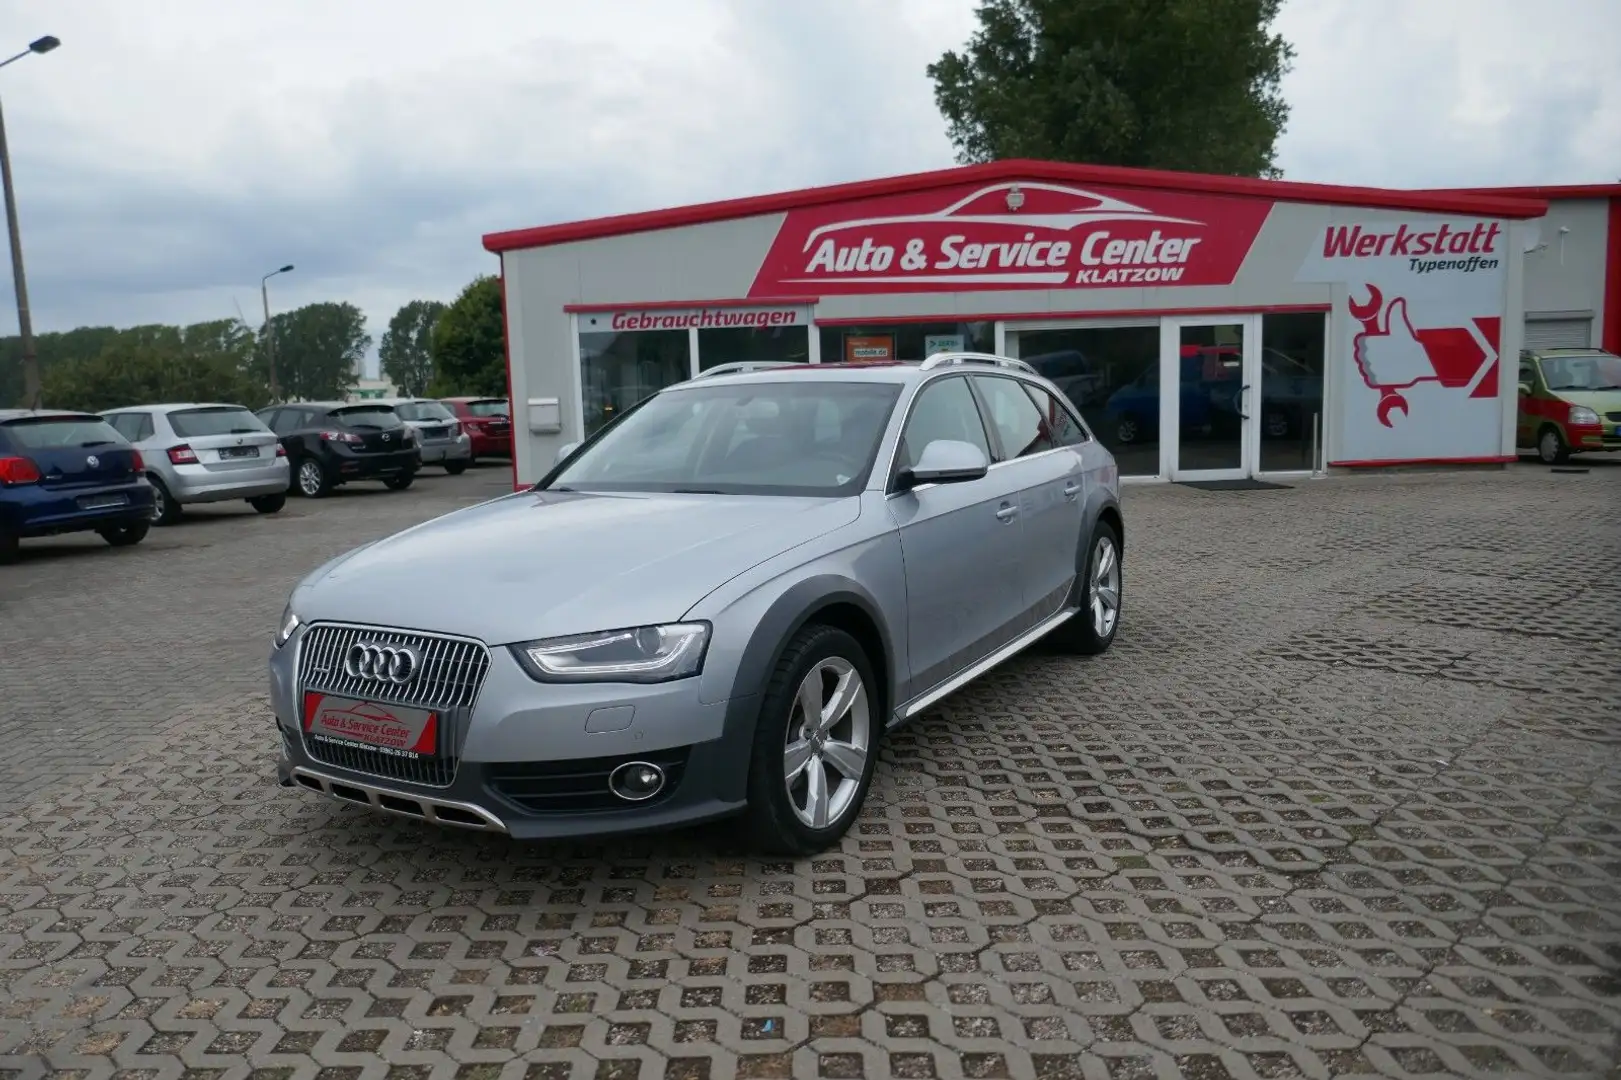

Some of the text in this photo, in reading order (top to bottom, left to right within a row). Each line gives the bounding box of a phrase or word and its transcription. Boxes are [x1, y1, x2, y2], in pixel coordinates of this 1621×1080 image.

[1323, 222, 1502, 258] Werkstatt
[805, 230, 1203, 273] Auto & Service Center
[1075, 267, 1185, 284] KLATZOW
[1409, 256, 1499, 274] Typenoffen
[612, 308, 796, 330] Gebrauchtwagen
[321, 714, 412, 738] Auto & Service Center
[363, 734, 407, 747] KLATZOW
